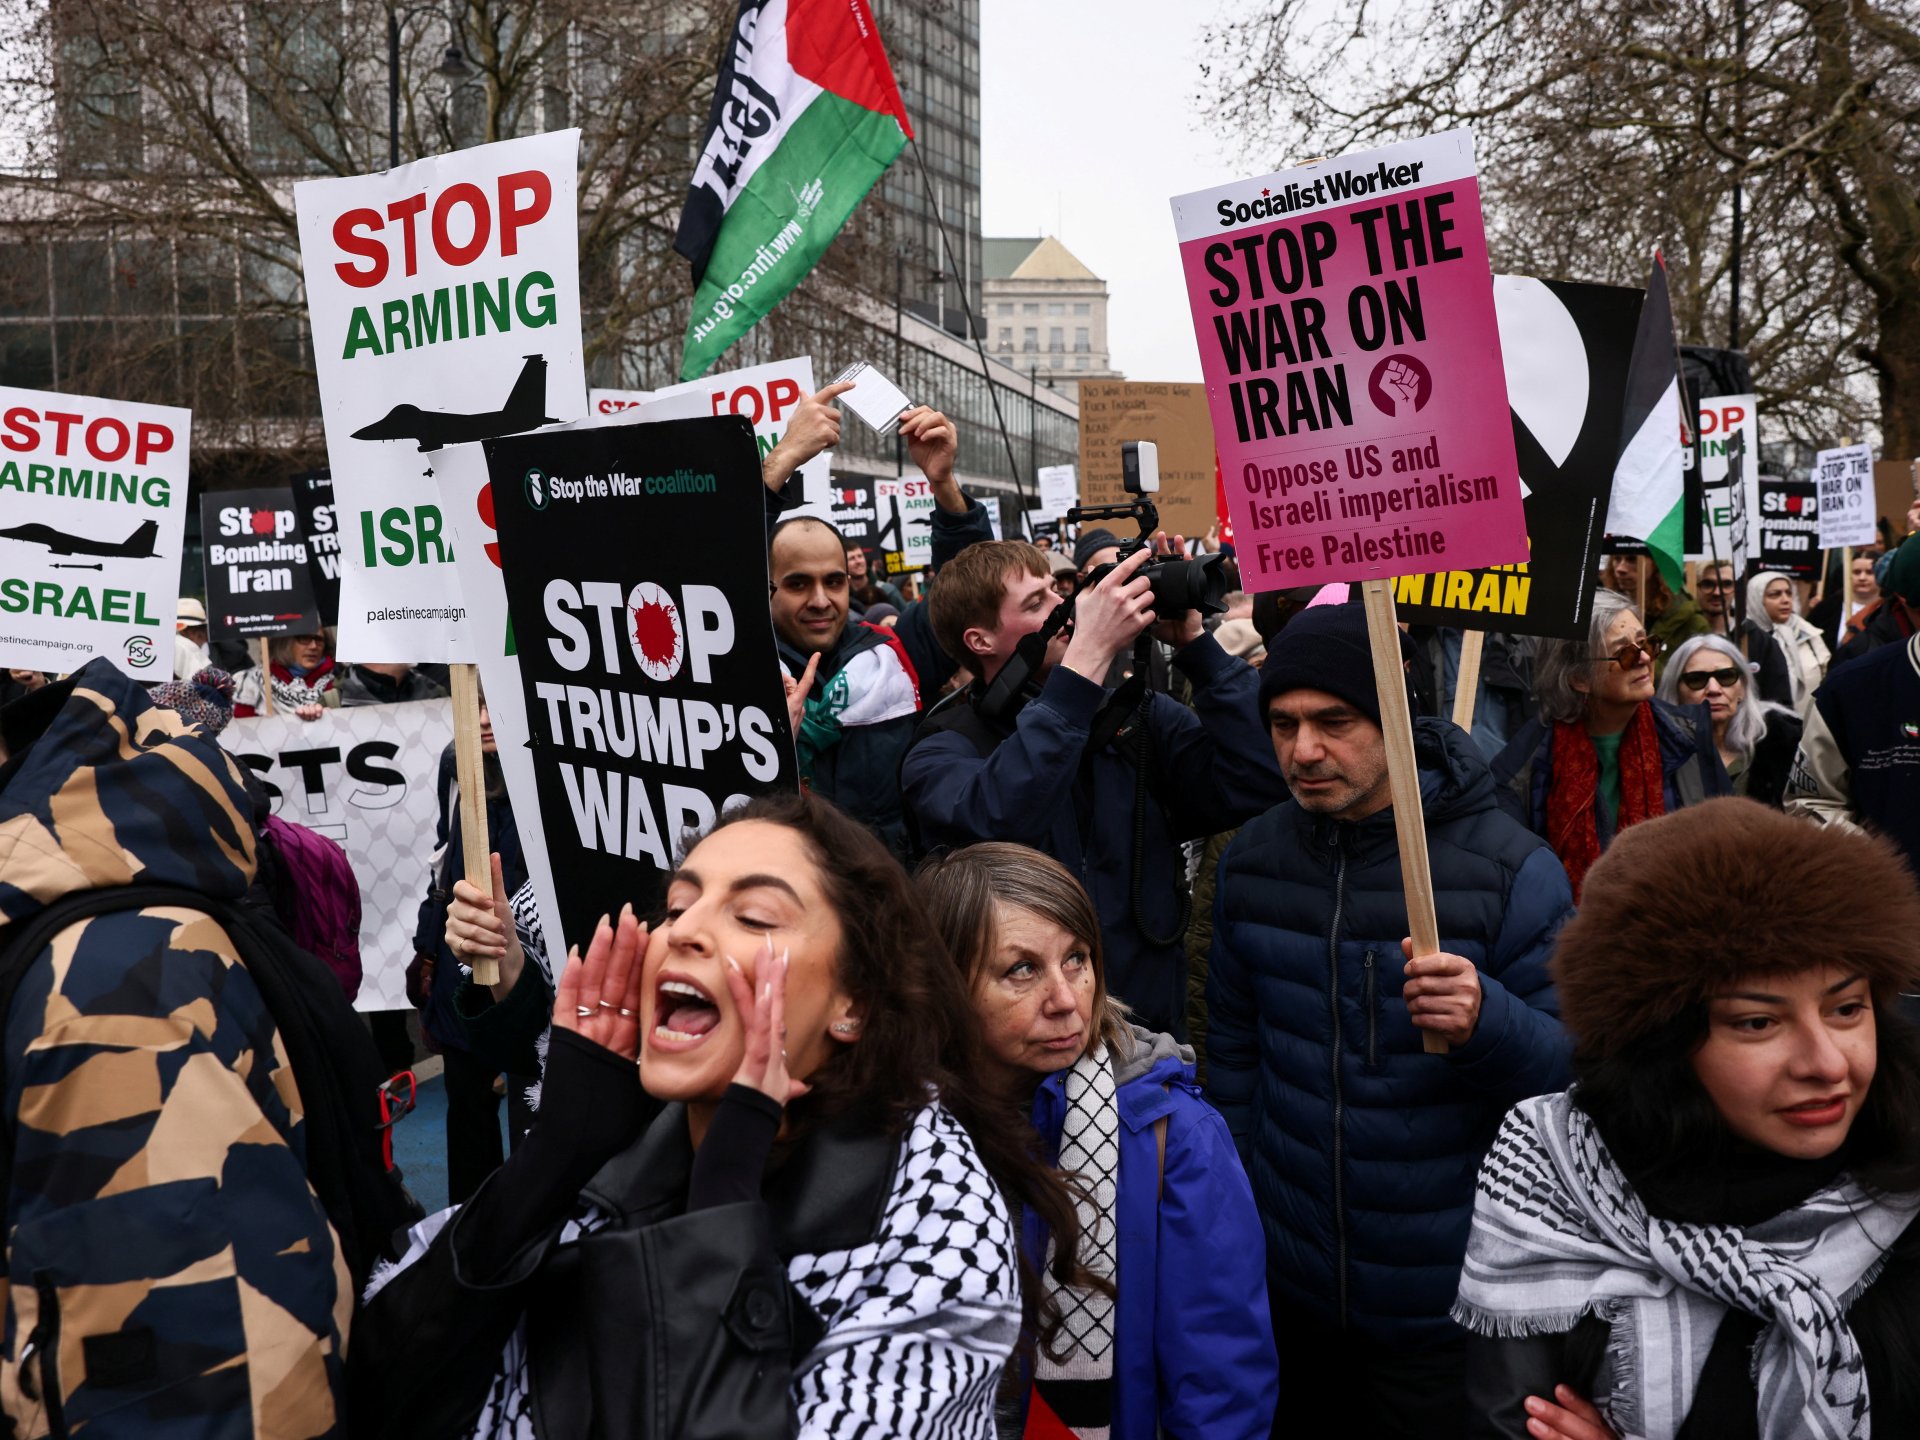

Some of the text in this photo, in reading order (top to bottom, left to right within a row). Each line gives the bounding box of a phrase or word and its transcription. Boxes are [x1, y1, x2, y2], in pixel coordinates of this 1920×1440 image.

[1217, 161, 1424, 226] Socialist Worker
[333, 170, 552, 288] STOP
[1203, 191, 1463, 308] STOP THE
[342, 270, 557, 360] ARMING
[1212, 275, 1427, 376] WAR ON
[1228, 363, 1354, 443] IRAN
[1, 407, 174, 465] STOP
[0, 461, 171, 508] ARMING
[550, 469, 716, 503] Stop the War coalition
[1243, 436, 1441, 497] Oppose US and
[1821, 457, 1869, 480] STOP THE
[1821, 476, 1862, 496] WAR ON
[219, 507, 295, 539] Stop
[905, 498, 934, 510] ARM
[1249, 473, 1499, 530] Israeli imperialism
[1763, 492, 1817, 516] Stop
[1821, 496, 1844, 512] IRAN
[360, 504, 456, 568] ISR
[836, 522, 867, 538] ran
[907, 535, 932, 548] ISR
[1256, 541, 1315, 574] Free
[1322, 527, 1446, 565] Palestine
[1764, 531, 1809, 551] Iran
[210, 541, 308, 565] Bombing
[0, 578, 160, 626] SRAEL
[228, 565, 292, 594] Iran
[1430, 572, 1531, 616] IRAN
[367, 604, 466, 624] palestinecampaign
[542, 578, 735, 684] STOP
[0, 635, 93, 653] estinecampaign.org
[129, 646, 151, 659] PSC
[536, 682, 779, 783] TRUMP'S
[558, 762, 756, 872] WAR
